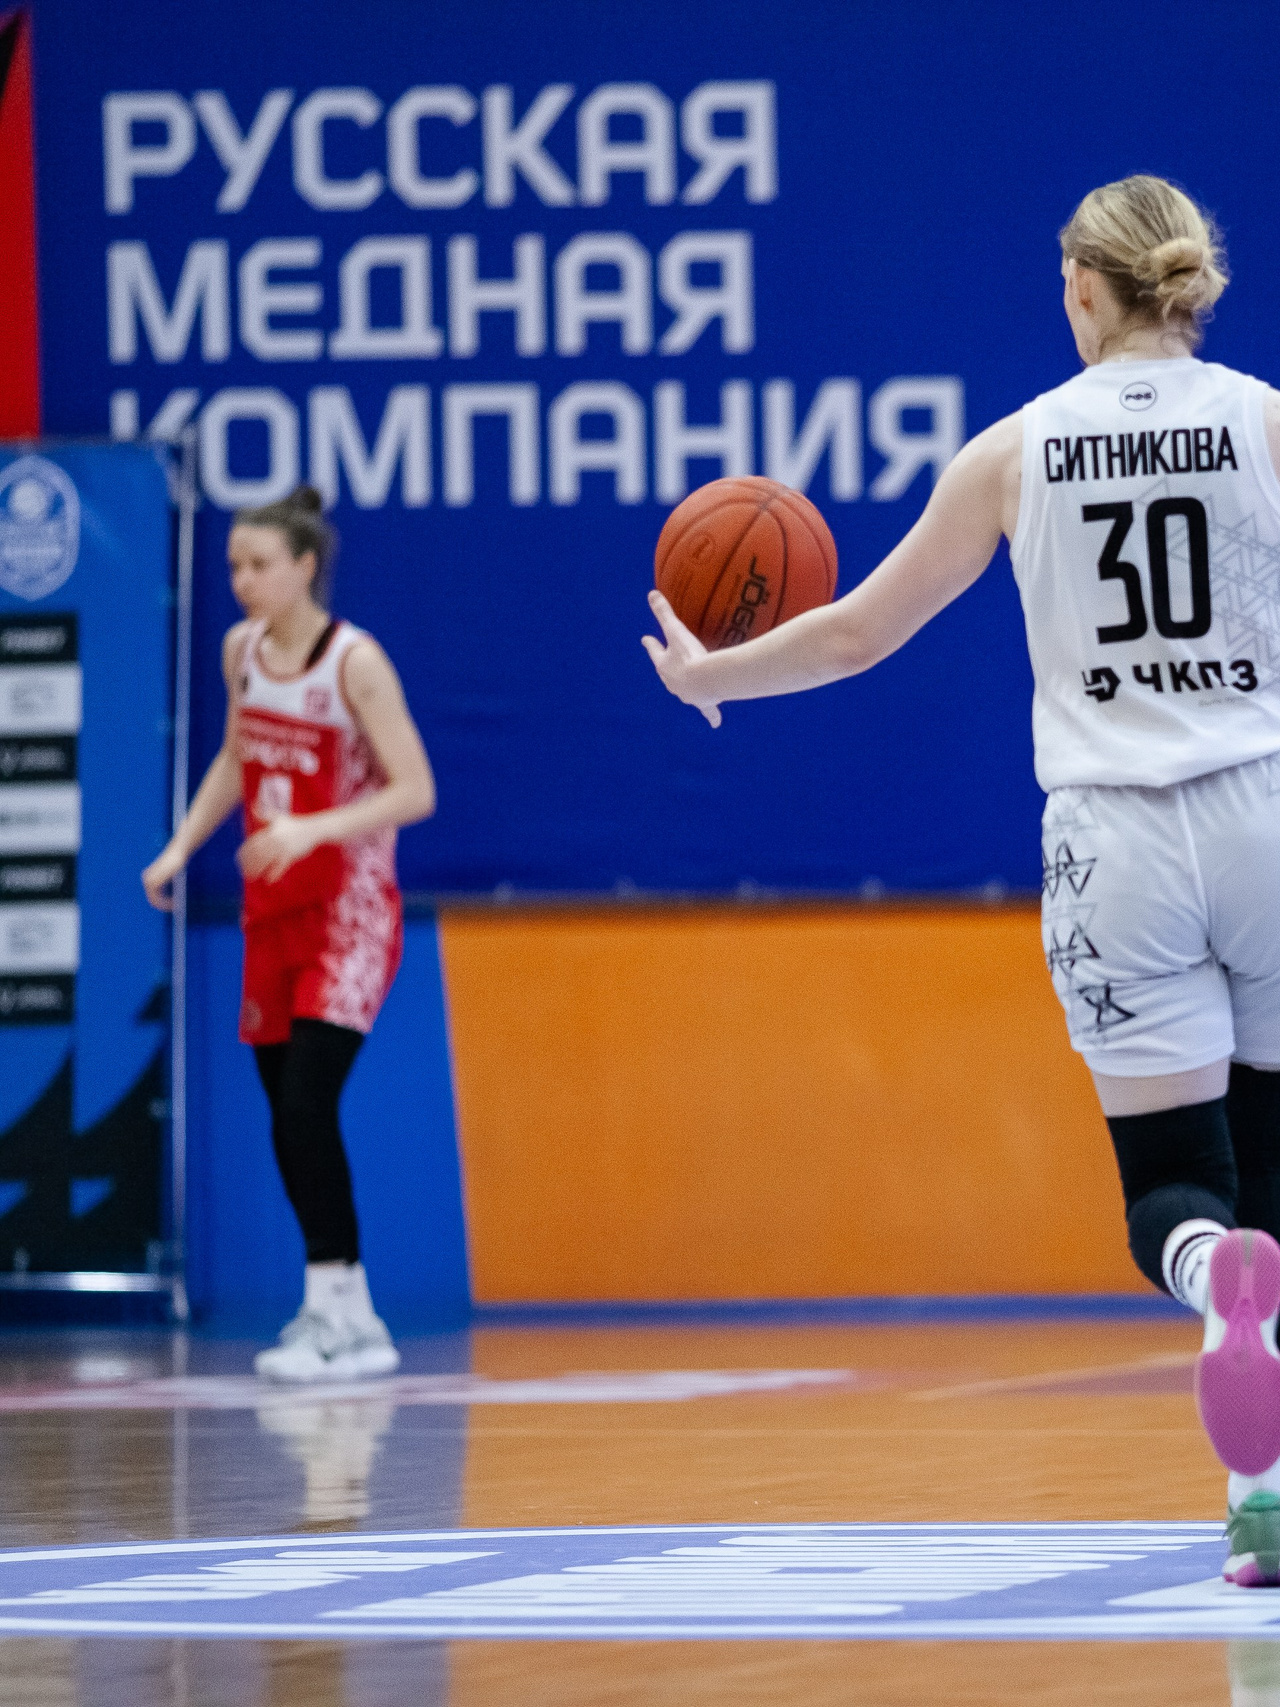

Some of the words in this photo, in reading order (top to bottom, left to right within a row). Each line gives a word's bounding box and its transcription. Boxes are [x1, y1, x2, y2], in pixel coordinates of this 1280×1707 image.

[103, 80, 779, 215] РУССКАЯ
[107, 230, 755, 365] МЕДНАЯ
[1045, 427, 1238, 483] СИТНИКОВА
[1082, 496, 1211, 644] 30
[1132, 659, 1258, 692] ЧКПЗ
